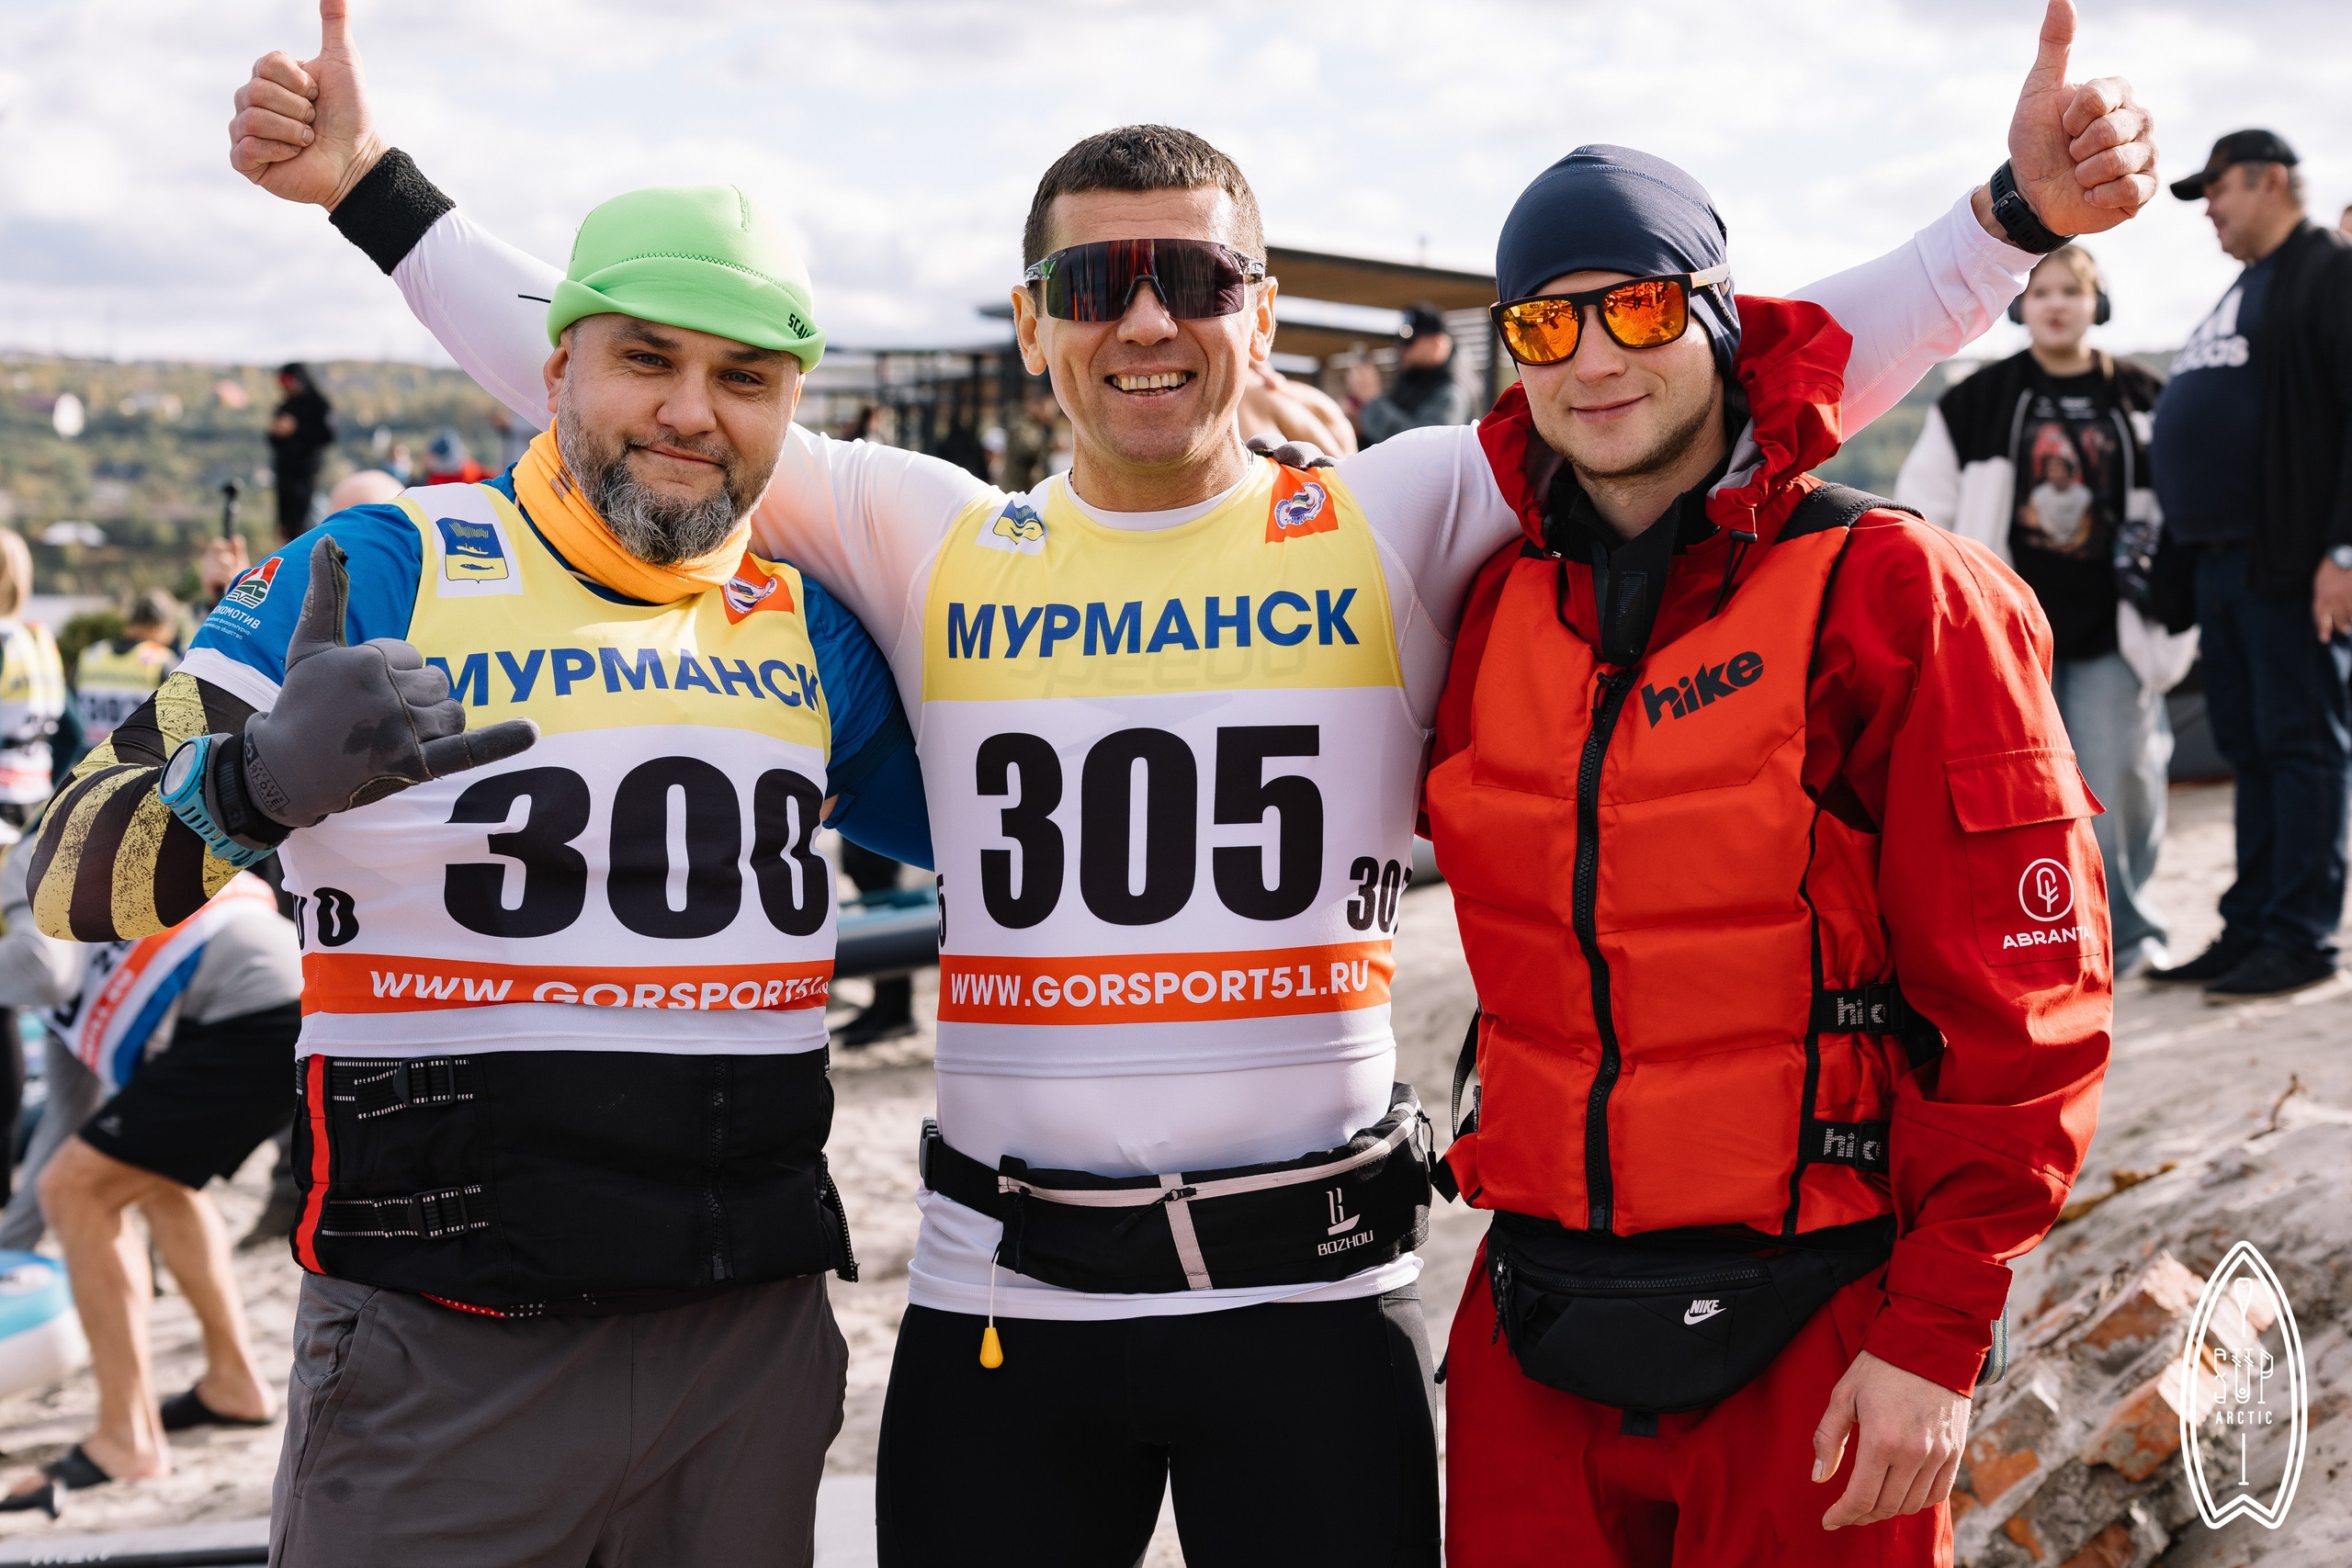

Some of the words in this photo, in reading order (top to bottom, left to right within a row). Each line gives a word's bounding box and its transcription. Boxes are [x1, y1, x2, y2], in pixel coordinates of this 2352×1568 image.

[212, 605, 261, 629] ОКОМОТИВ
[947, 588, 1361, 660] МУРМАНСК
[425, 647, 821, 713] МУРМАНСК
[1640, 650, 1765, 730] hike
[252, 764, 280, 807] GLOVE
[444, 755, 829, 939] 300
[976, 724, 1324, 930] 305
[2003, 926, 2091, 950] ABRANTA
[951, 959, 1369, 1008] WWW.GORSPORT51.RU
[1317, 1229, 1374, 1256] BOZHOU
[1690, 1299, 1720, 1314] NIKE
